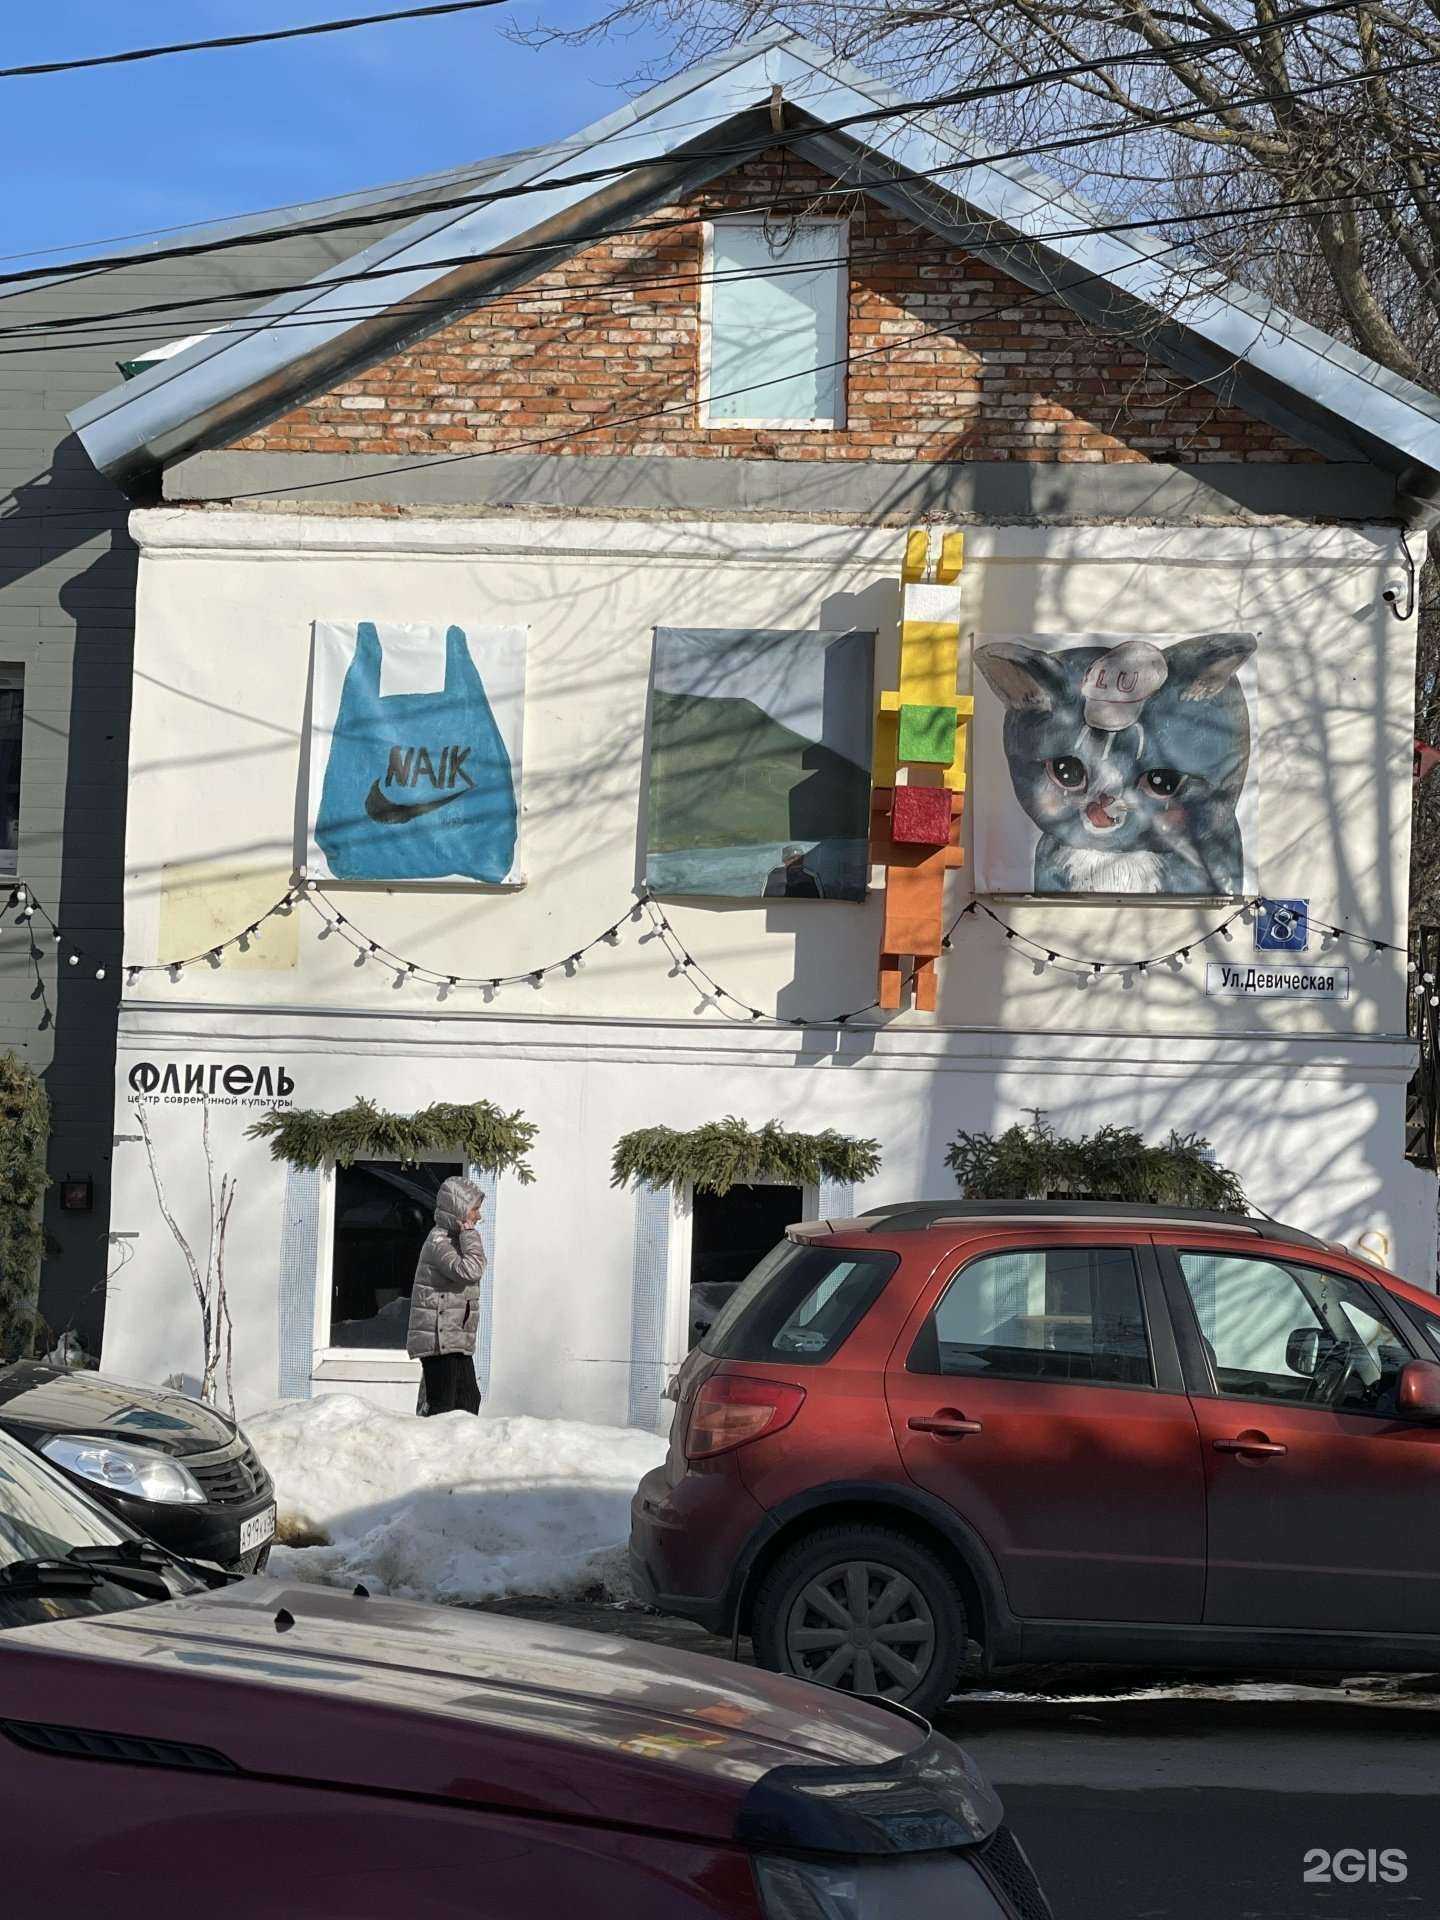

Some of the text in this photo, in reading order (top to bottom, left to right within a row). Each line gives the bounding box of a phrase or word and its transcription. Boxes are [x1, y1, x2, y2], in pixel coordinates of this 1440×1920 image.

[384, 745, 477, 789] NAIK
[1270, 908, 1295, 942] 8
[241, 1098, 293, 1108] культуры
